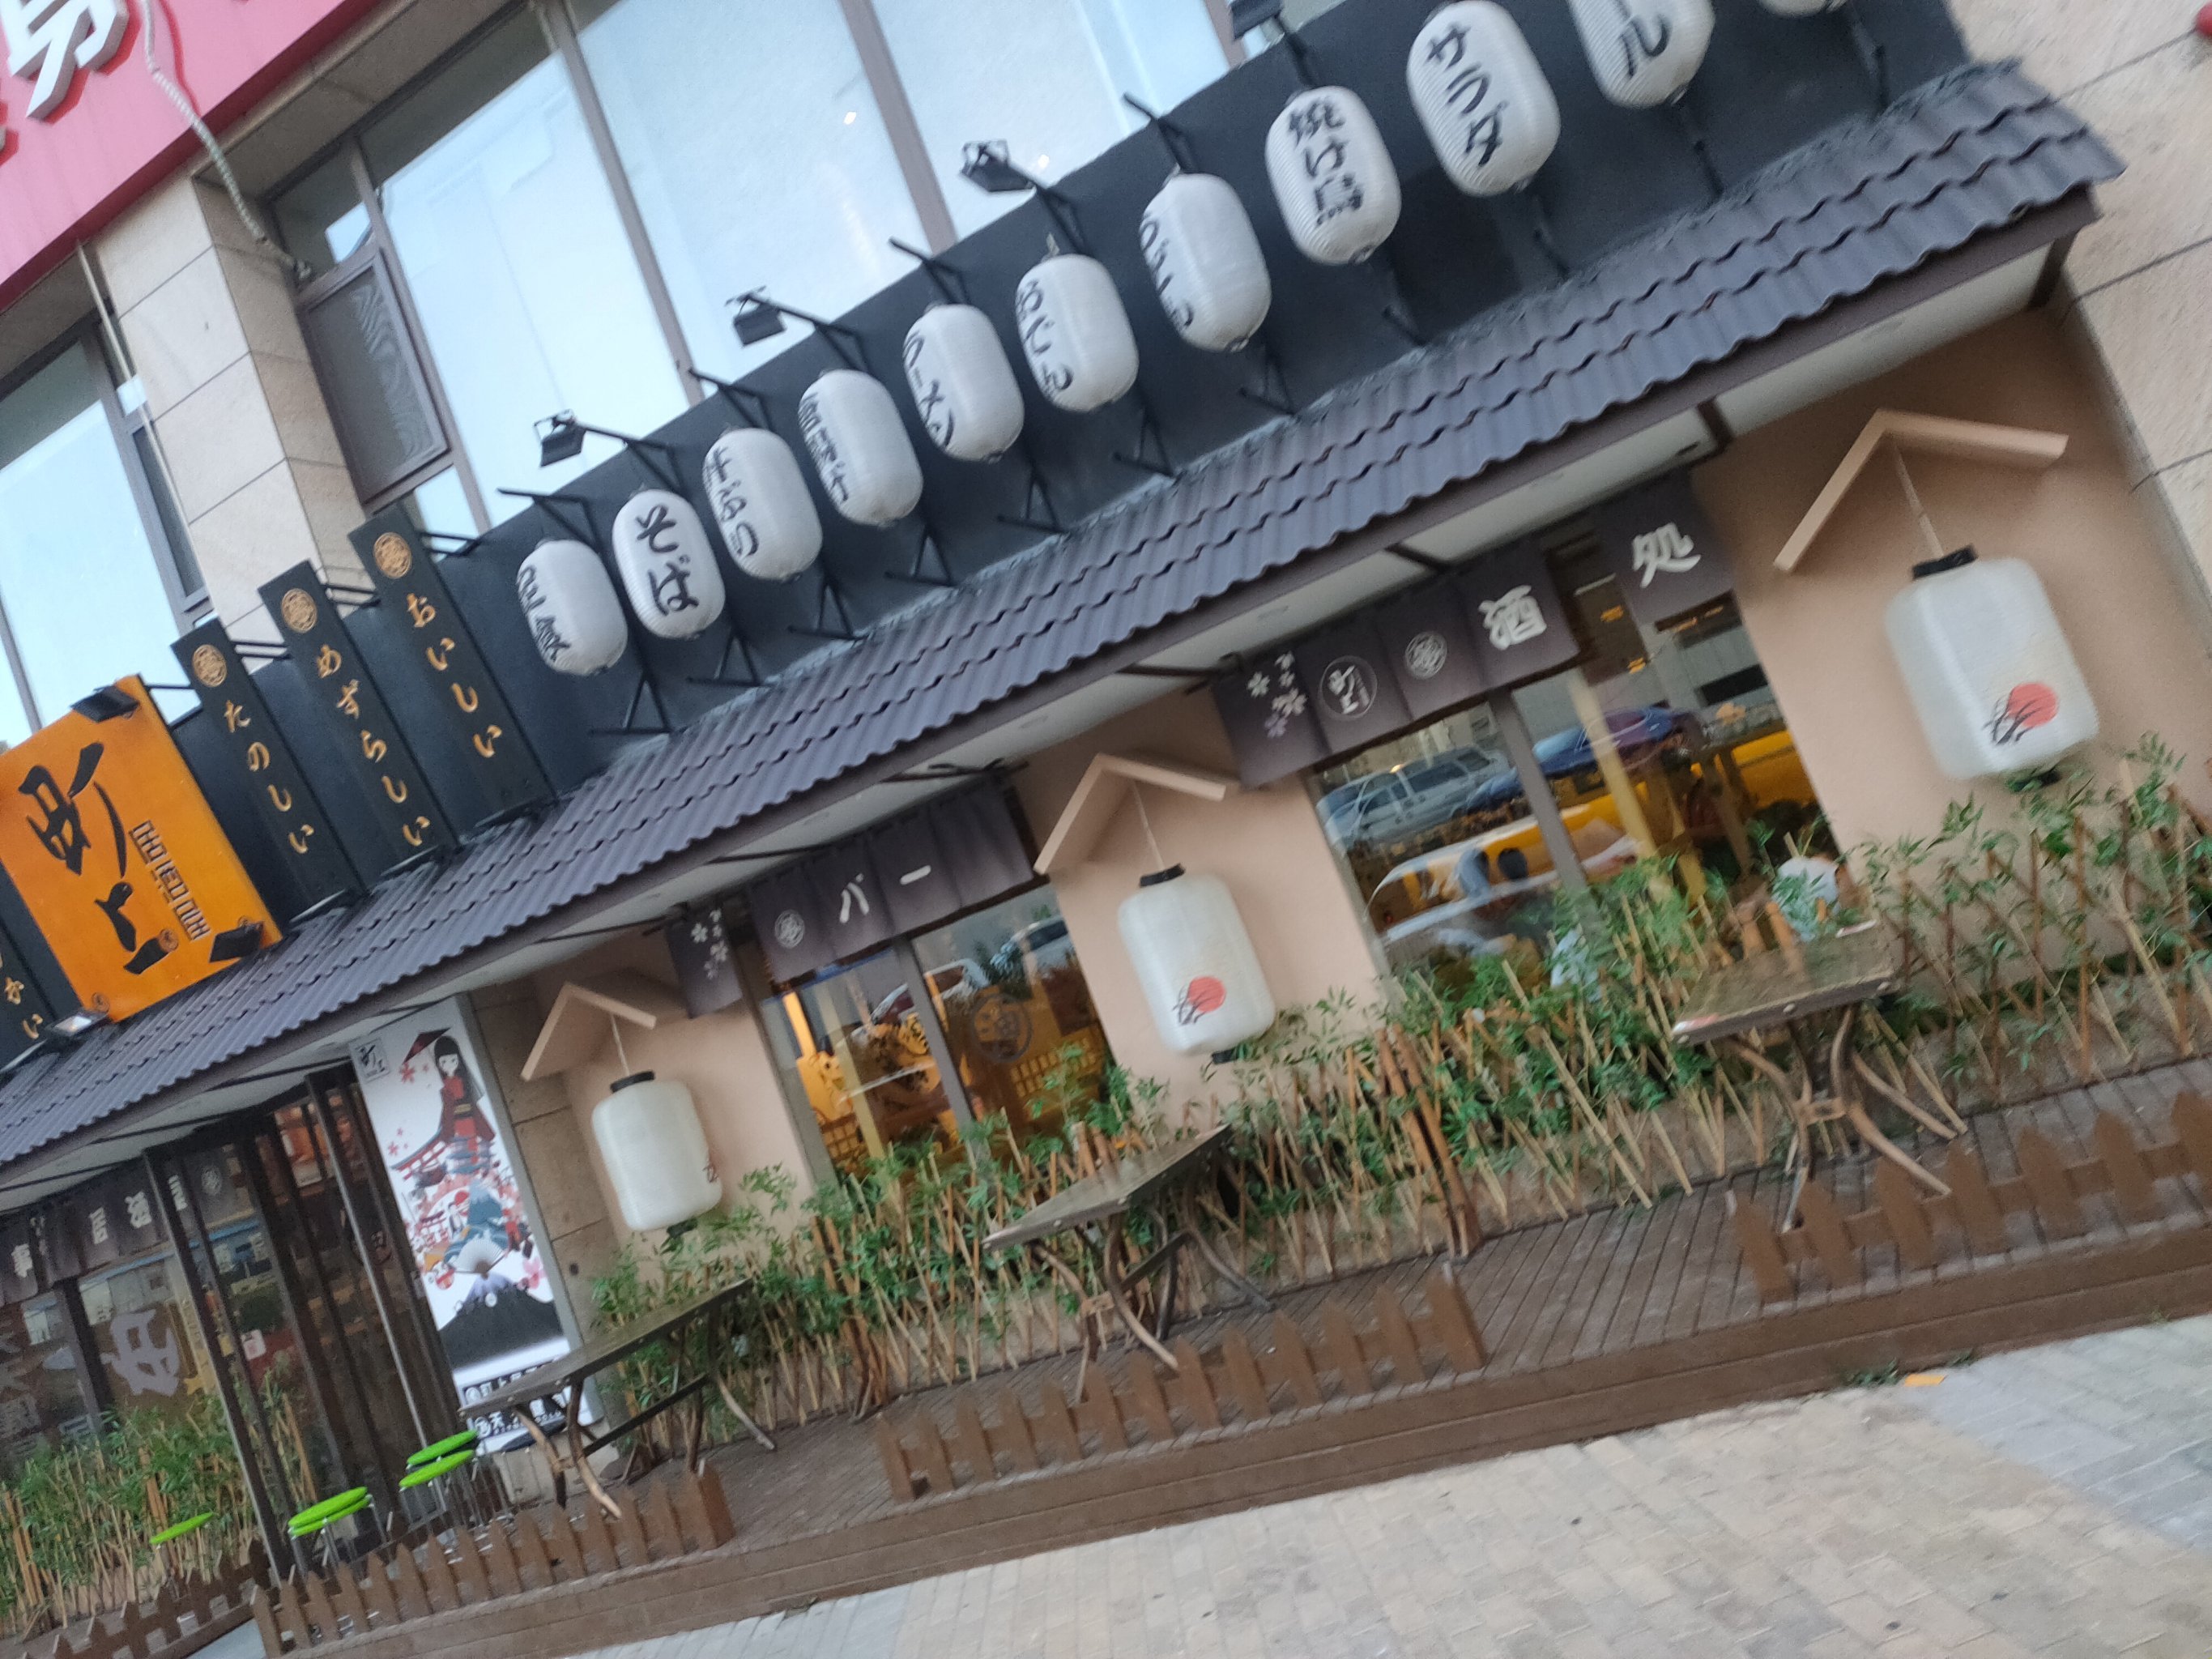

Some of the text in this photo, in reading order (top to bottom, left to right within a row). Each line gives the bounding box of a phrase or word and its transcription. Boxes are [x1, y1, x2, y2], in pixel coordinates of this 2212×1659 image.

[637, 504, 699, 616] そば
[316, 644, 431, 847] めずらしい
[405, 593, 502, 757] おいしい
[224, 699, 315, 855] たのしい
